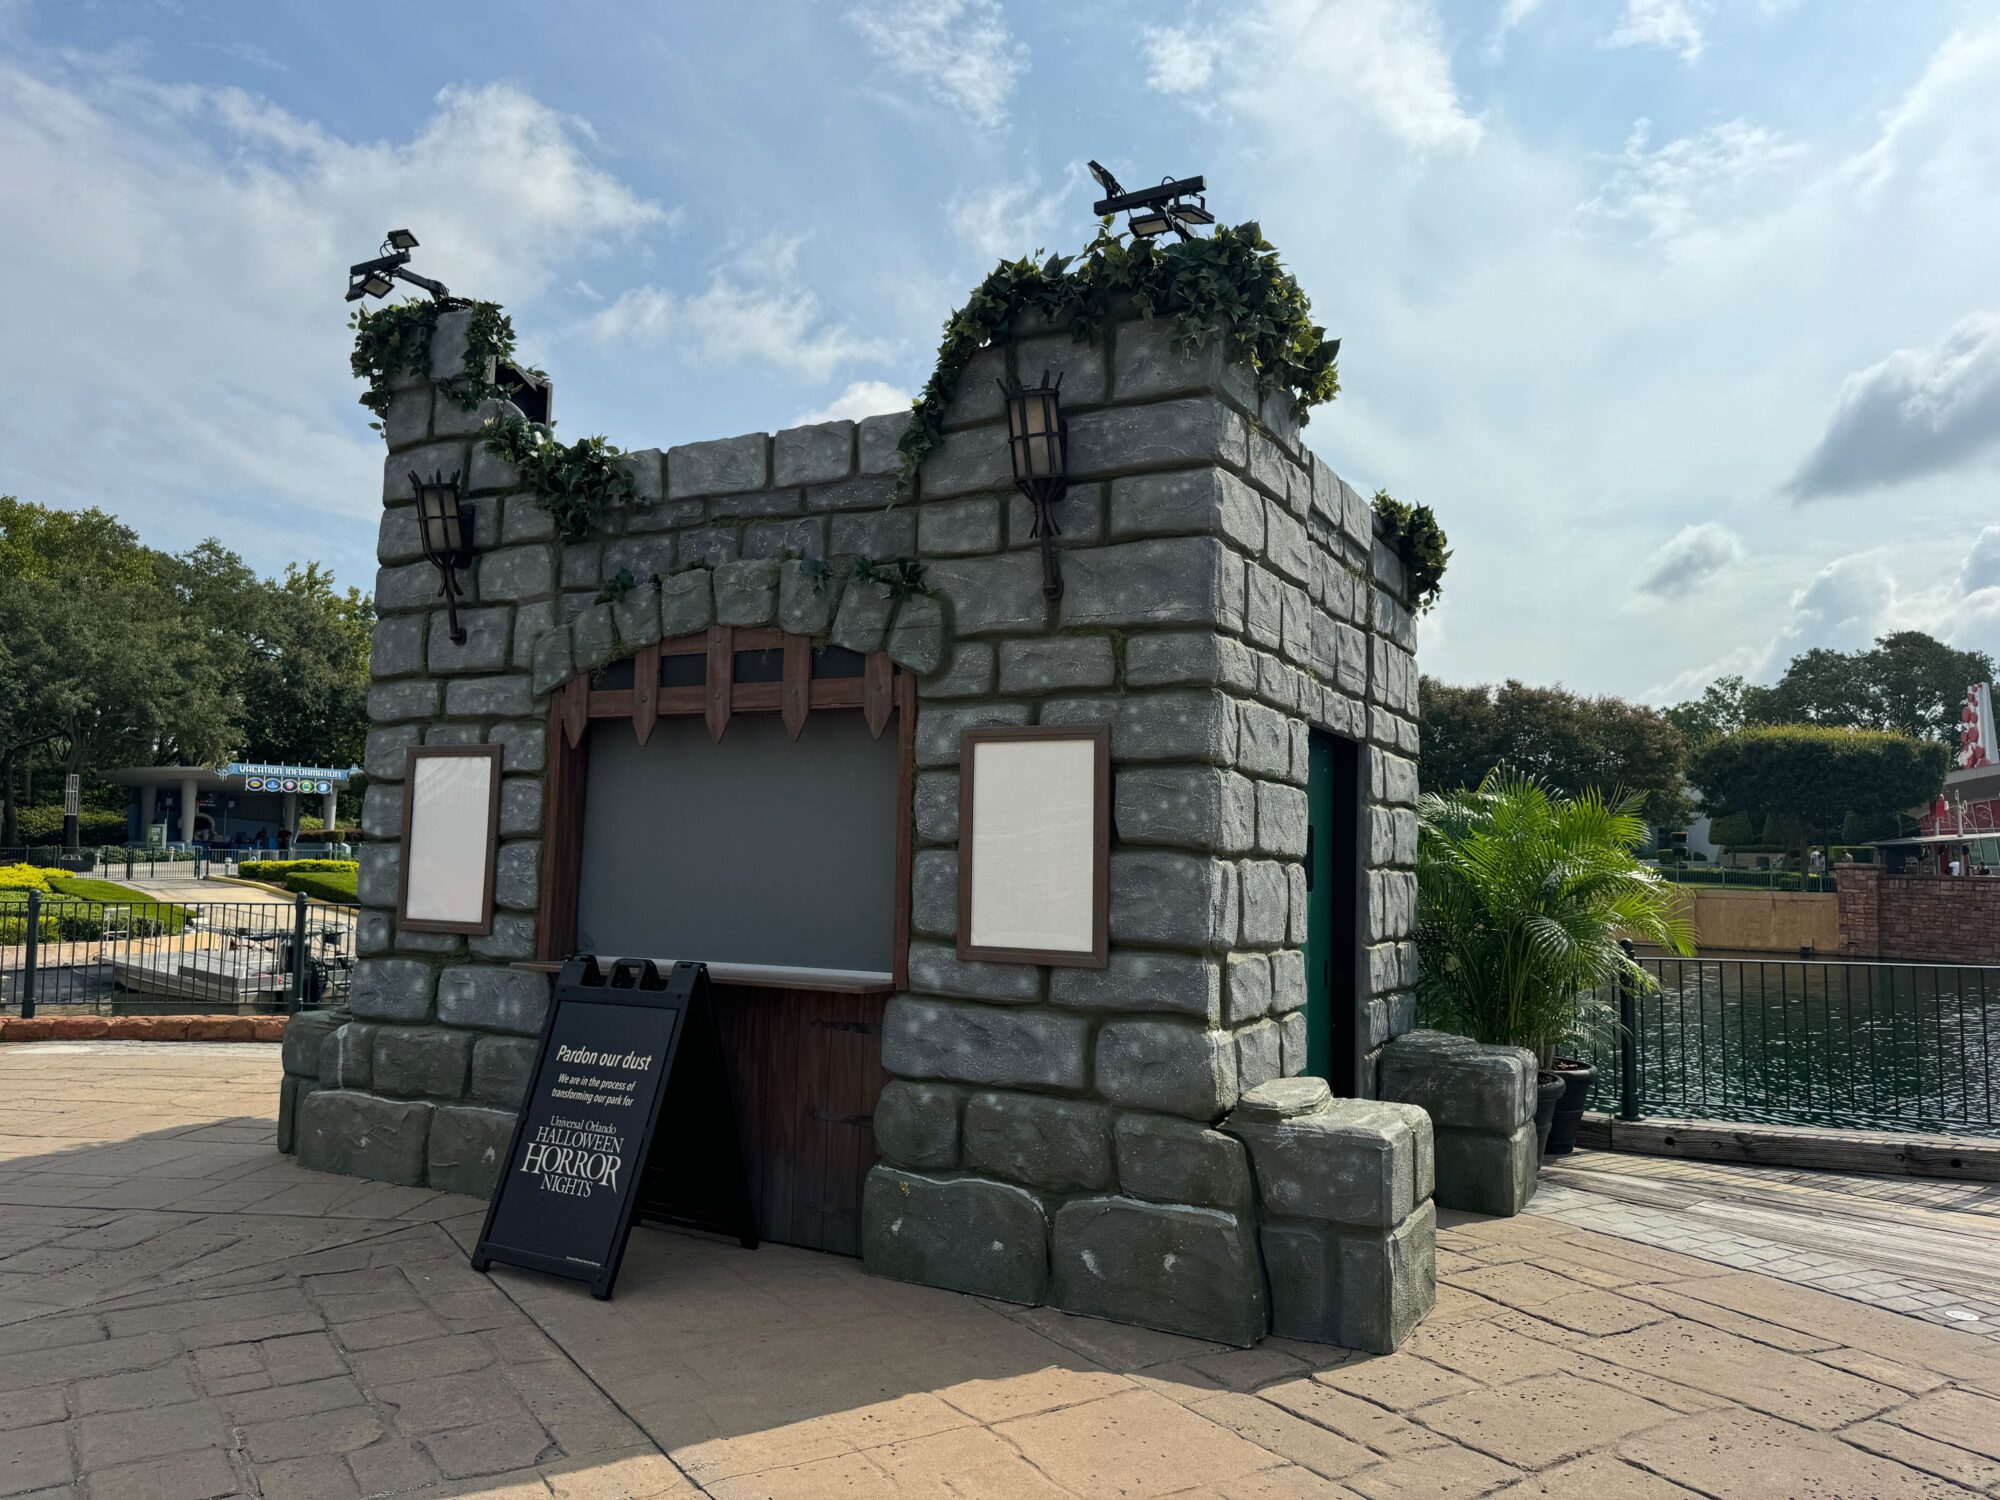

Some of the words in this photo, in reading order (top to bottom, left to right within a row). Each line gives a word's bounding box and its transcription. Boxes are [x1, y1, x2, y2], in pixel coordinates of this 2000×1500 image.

[239, 765, 282, 775] VACATION
[286, 767, 341, 778] INFORMATION
[556, 1044, 597, 1064] Pardon
[599, 1053, 622, 1067] our
[622, 1050, 652, 1070] dust
[558, 1073, 568, 1084] We
[569, 1076, 580, 1085] are
[580, 1076, 588, 1085] in
[588, 1076, 600, 1087] the
[599, 1080, 626, 1090] process
[626, 1081, 636, 1091] of
[551, 1088, 593, 1104] transforming
[593, 1094, 607, 1103] our
[605, 1095, 622, 1106] park
[622, 1095, 634, 1106] for
[550, 1115, 584, 1129] Universal
[585, 1120, 617, 1134] Orlando
[535, 1126, 624, 1154] HALLOWEEN
[520, 1142, 622, 1194] HORROR
[540, 1173, 593, 1198] NIGHTS
